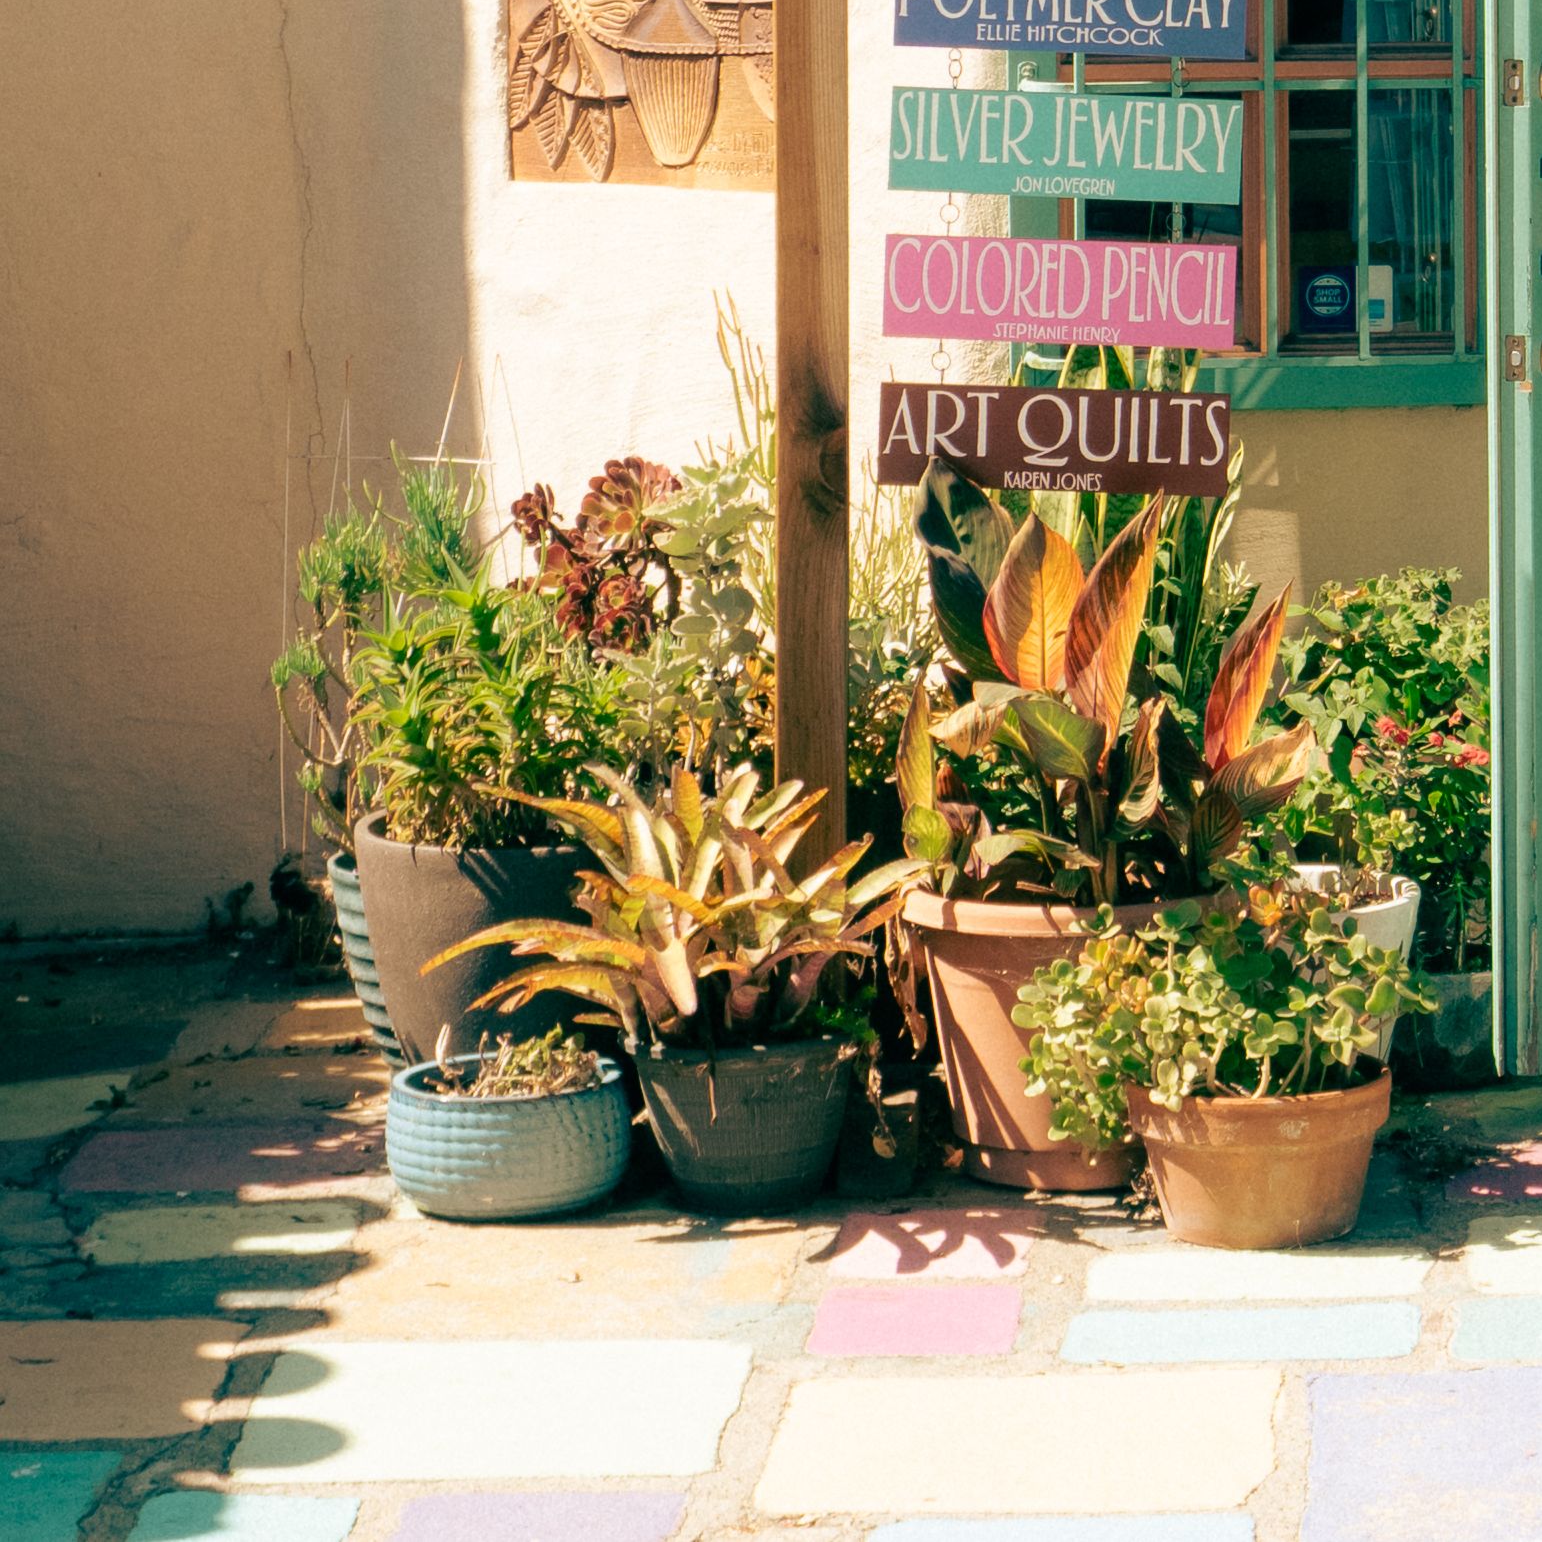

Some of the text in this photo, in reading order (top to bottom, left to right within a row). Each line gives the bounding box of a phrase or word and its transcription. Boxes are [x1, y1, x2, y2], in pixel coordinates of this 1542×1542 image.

[976, 24, 1165, 48] ELLIE HITCHCOCK
[892, 90, 1242, 174] SILVER JEWELRY
[1010, 176, 1116, 198] JON LOVEGREN
[888, 236, 1231, 327] COLORED PENCIL
[1315, 288, 1341, 296] SHOP
[1313, 295, 1343, 304] SMALL
[992, 323, 1122, 345] STEPHANIE HENRY
[881, 388, 1227, 468] ART QUILTS
[1003, 470, 1103, 492] KAREN JONES
